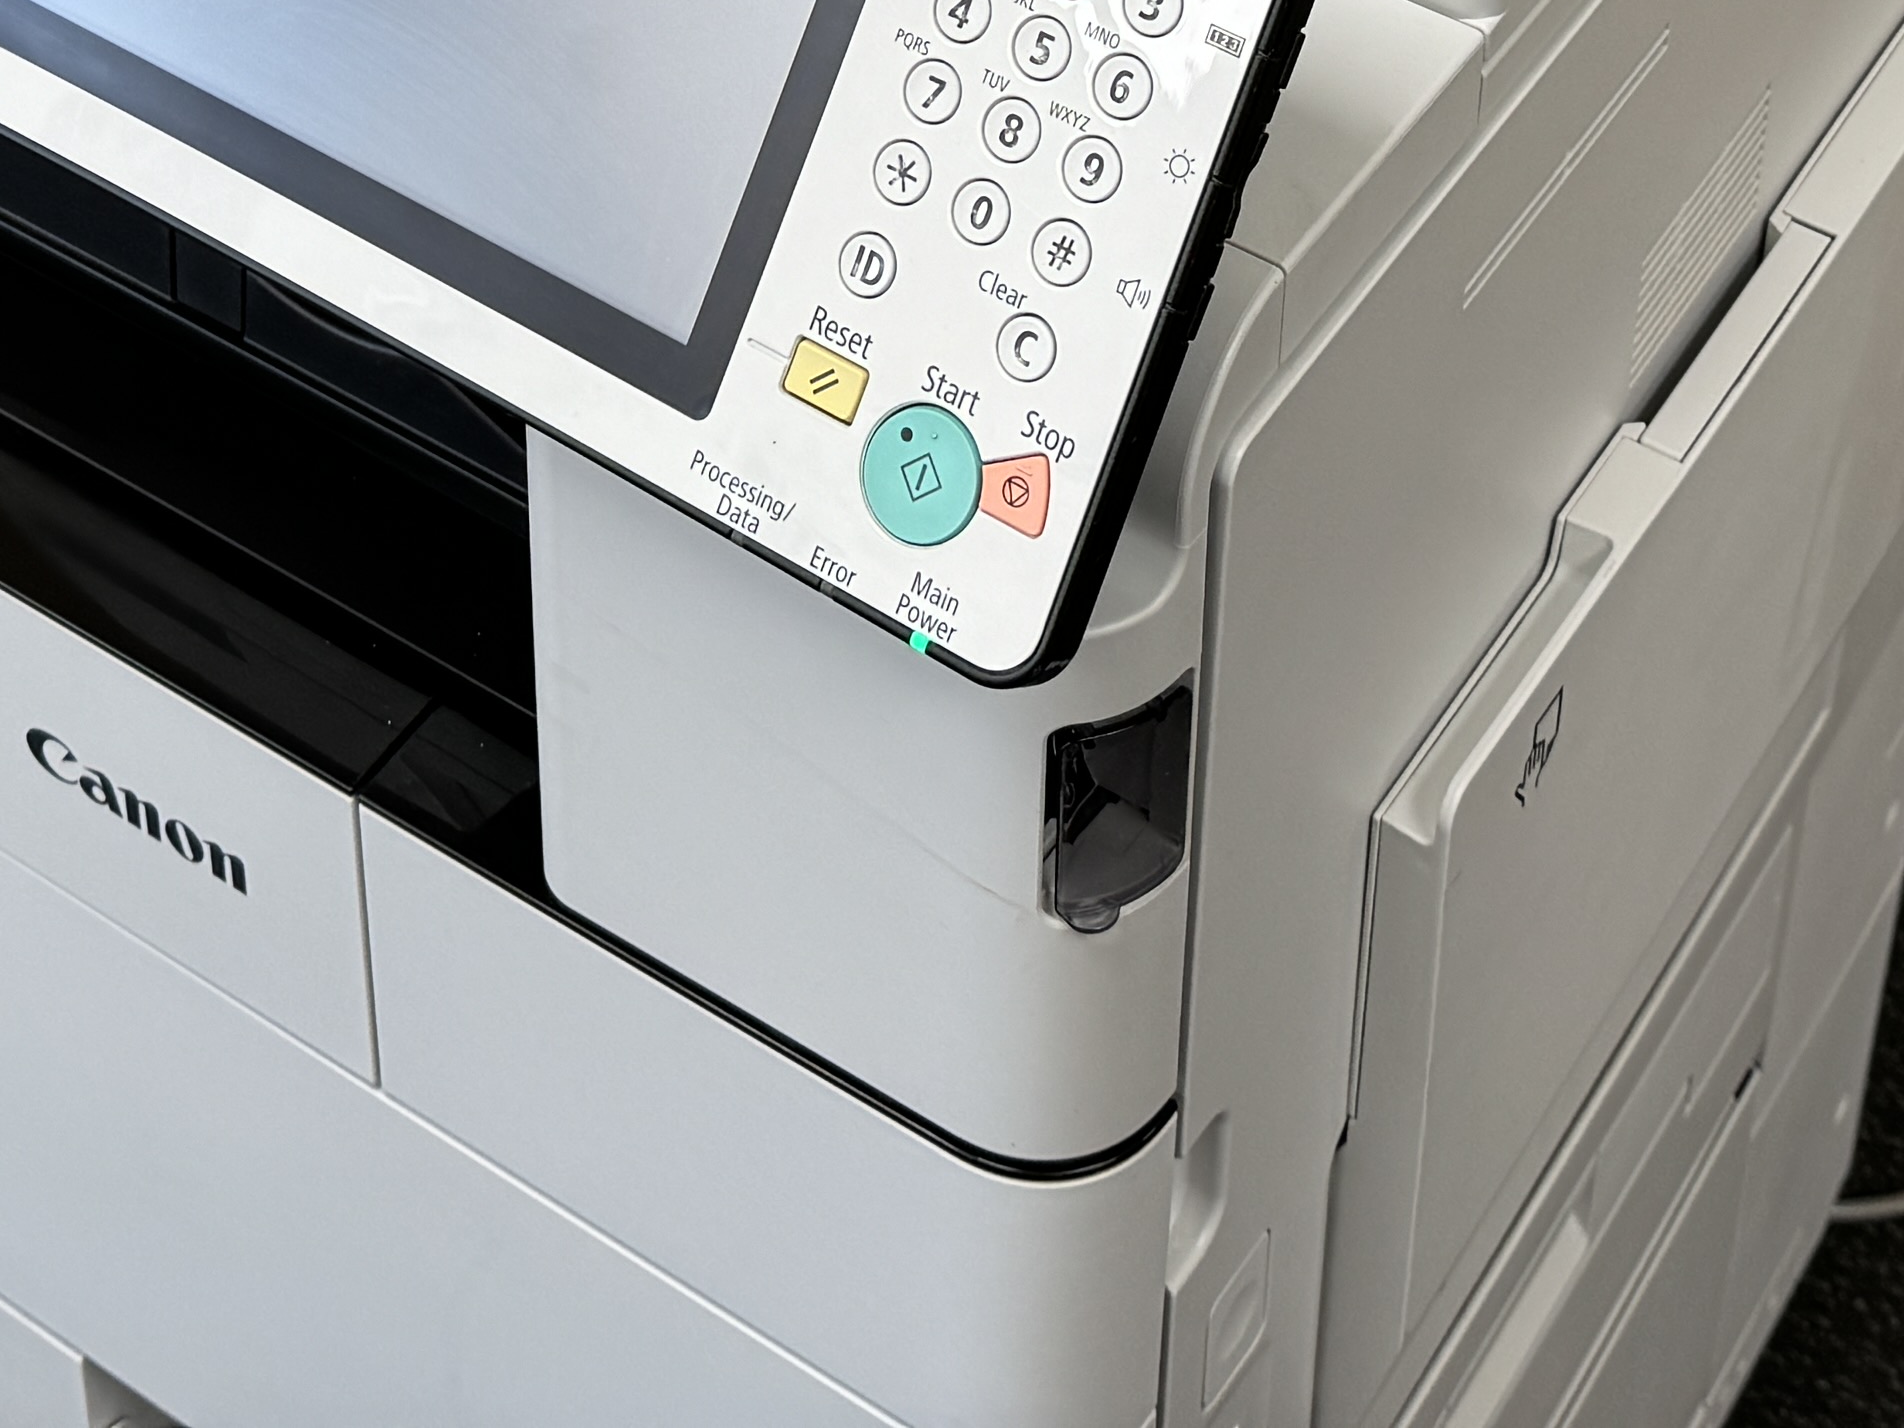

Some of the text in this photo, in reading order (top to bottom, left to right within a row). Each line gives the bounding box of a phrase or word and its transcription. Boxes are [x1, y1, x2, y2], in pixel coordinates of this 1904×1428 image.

[895, 29, 931, 56] PQRS
[1031, 31, 1052, 66] 5
[1085, 22, 1120, 49] MNO
[922, 75, 946, 109] 7
[981, 69, 1010, 92] TUV
[1110, 69, 1133, 104] 6
[999, 113, 1023, 148] 8
[1049, 101, 1091, 133] WXYZ
[1080, 150, 1105, 185] 9
[970, 196, 993, 230] 0
[850, 245, 886, 286] ID
[1047, 236, 1076, 270] #
[978, 270, 1027, 310] Clear
[810, 306, 873, 360] Reset
[1014, 330, 1039, 367] C
[921, 365, 980, 417] Start
[1021, 410, 1075, 462] Stop
[690, 449, 796, 522] Processing/
[716, 494, 761, 534] Data
[810, 546, 857, 588] Error
[911, 572, 960, 615] Main
[895, 594, 958, 643] Power
[26, 726, 249, 896] Canon
